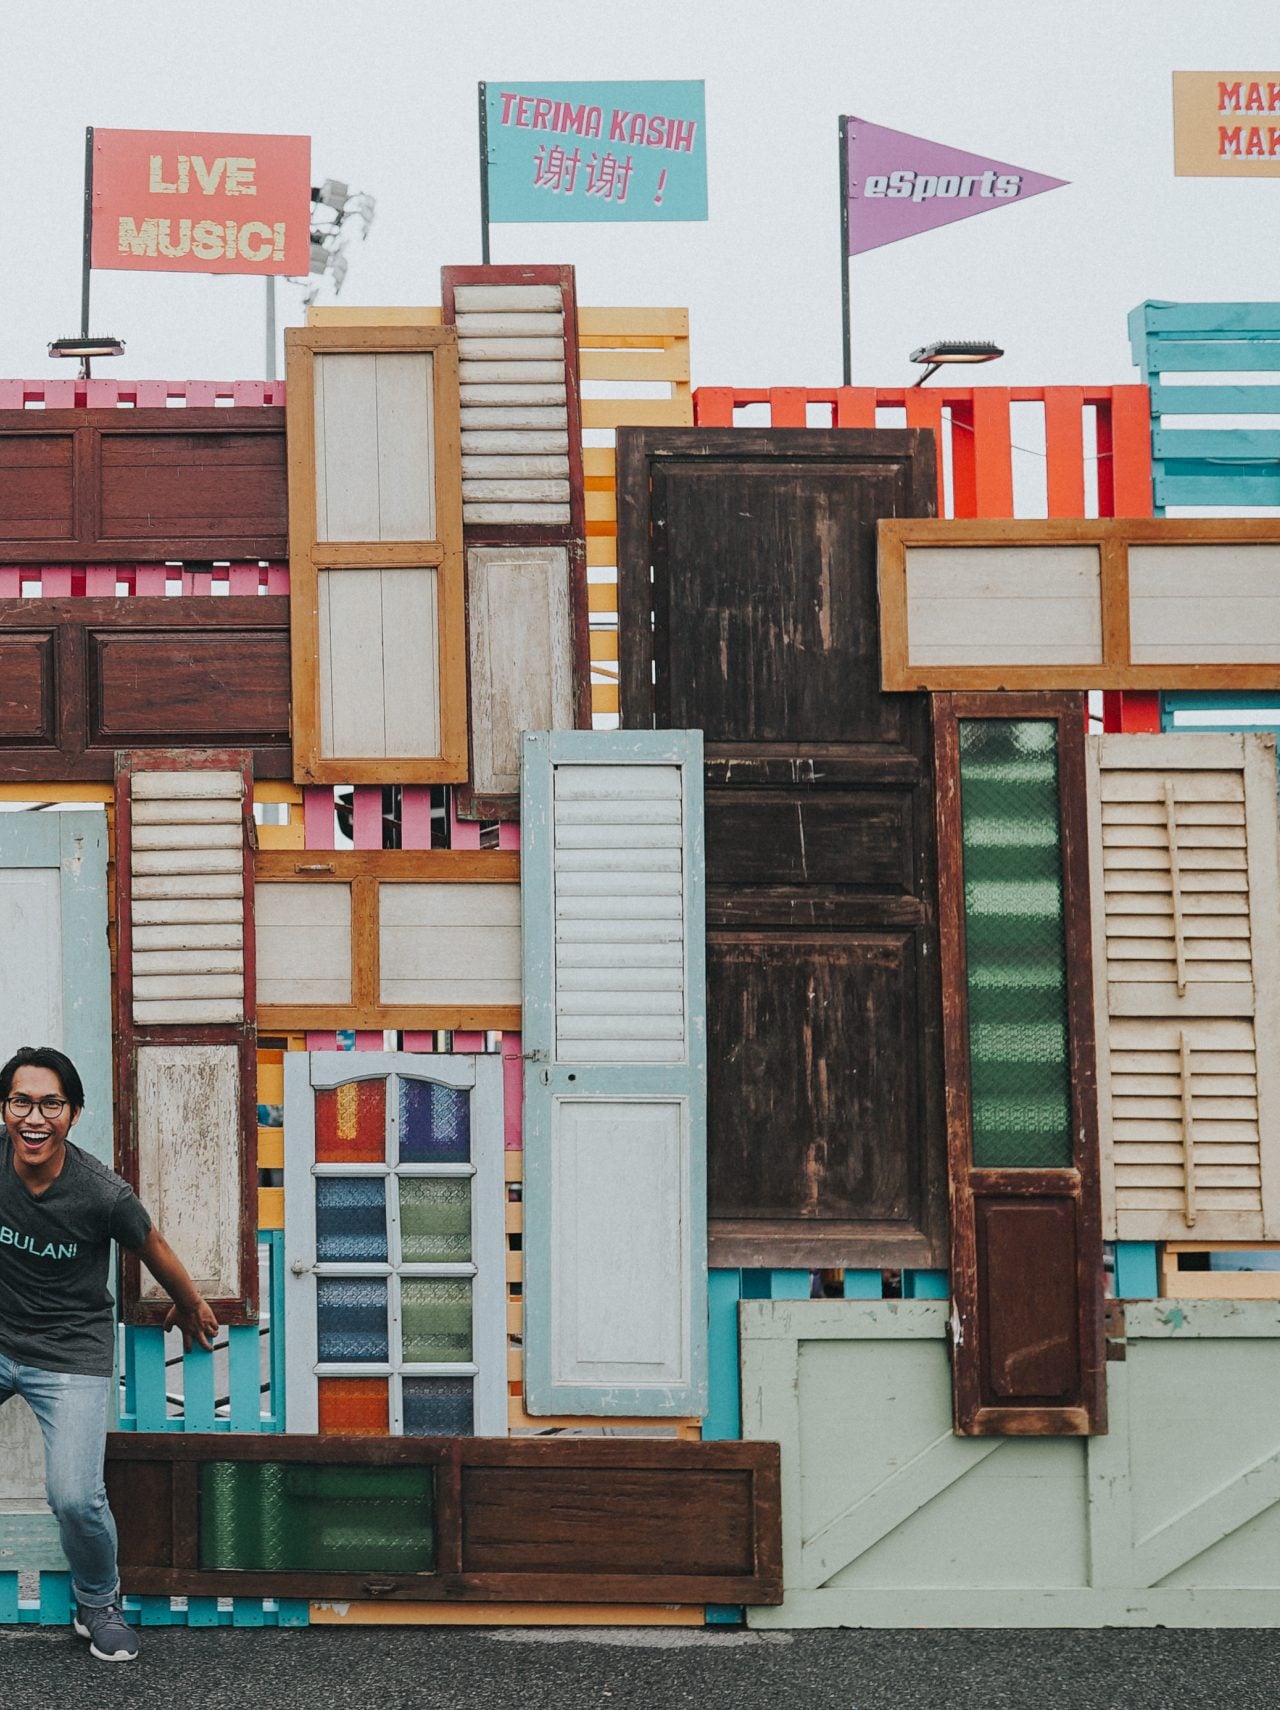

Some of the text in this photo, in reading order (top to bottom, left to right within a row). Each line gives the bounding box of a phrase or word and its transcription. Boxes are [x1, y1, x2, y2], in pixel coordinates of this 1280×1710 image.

[499, 91, 697, 153] TERIMA KASIH
[148, 154, 258, 197] LIVE
[863, 170, 1023, 203] eSports
[116, 216, 286, 264] MUSIC!
